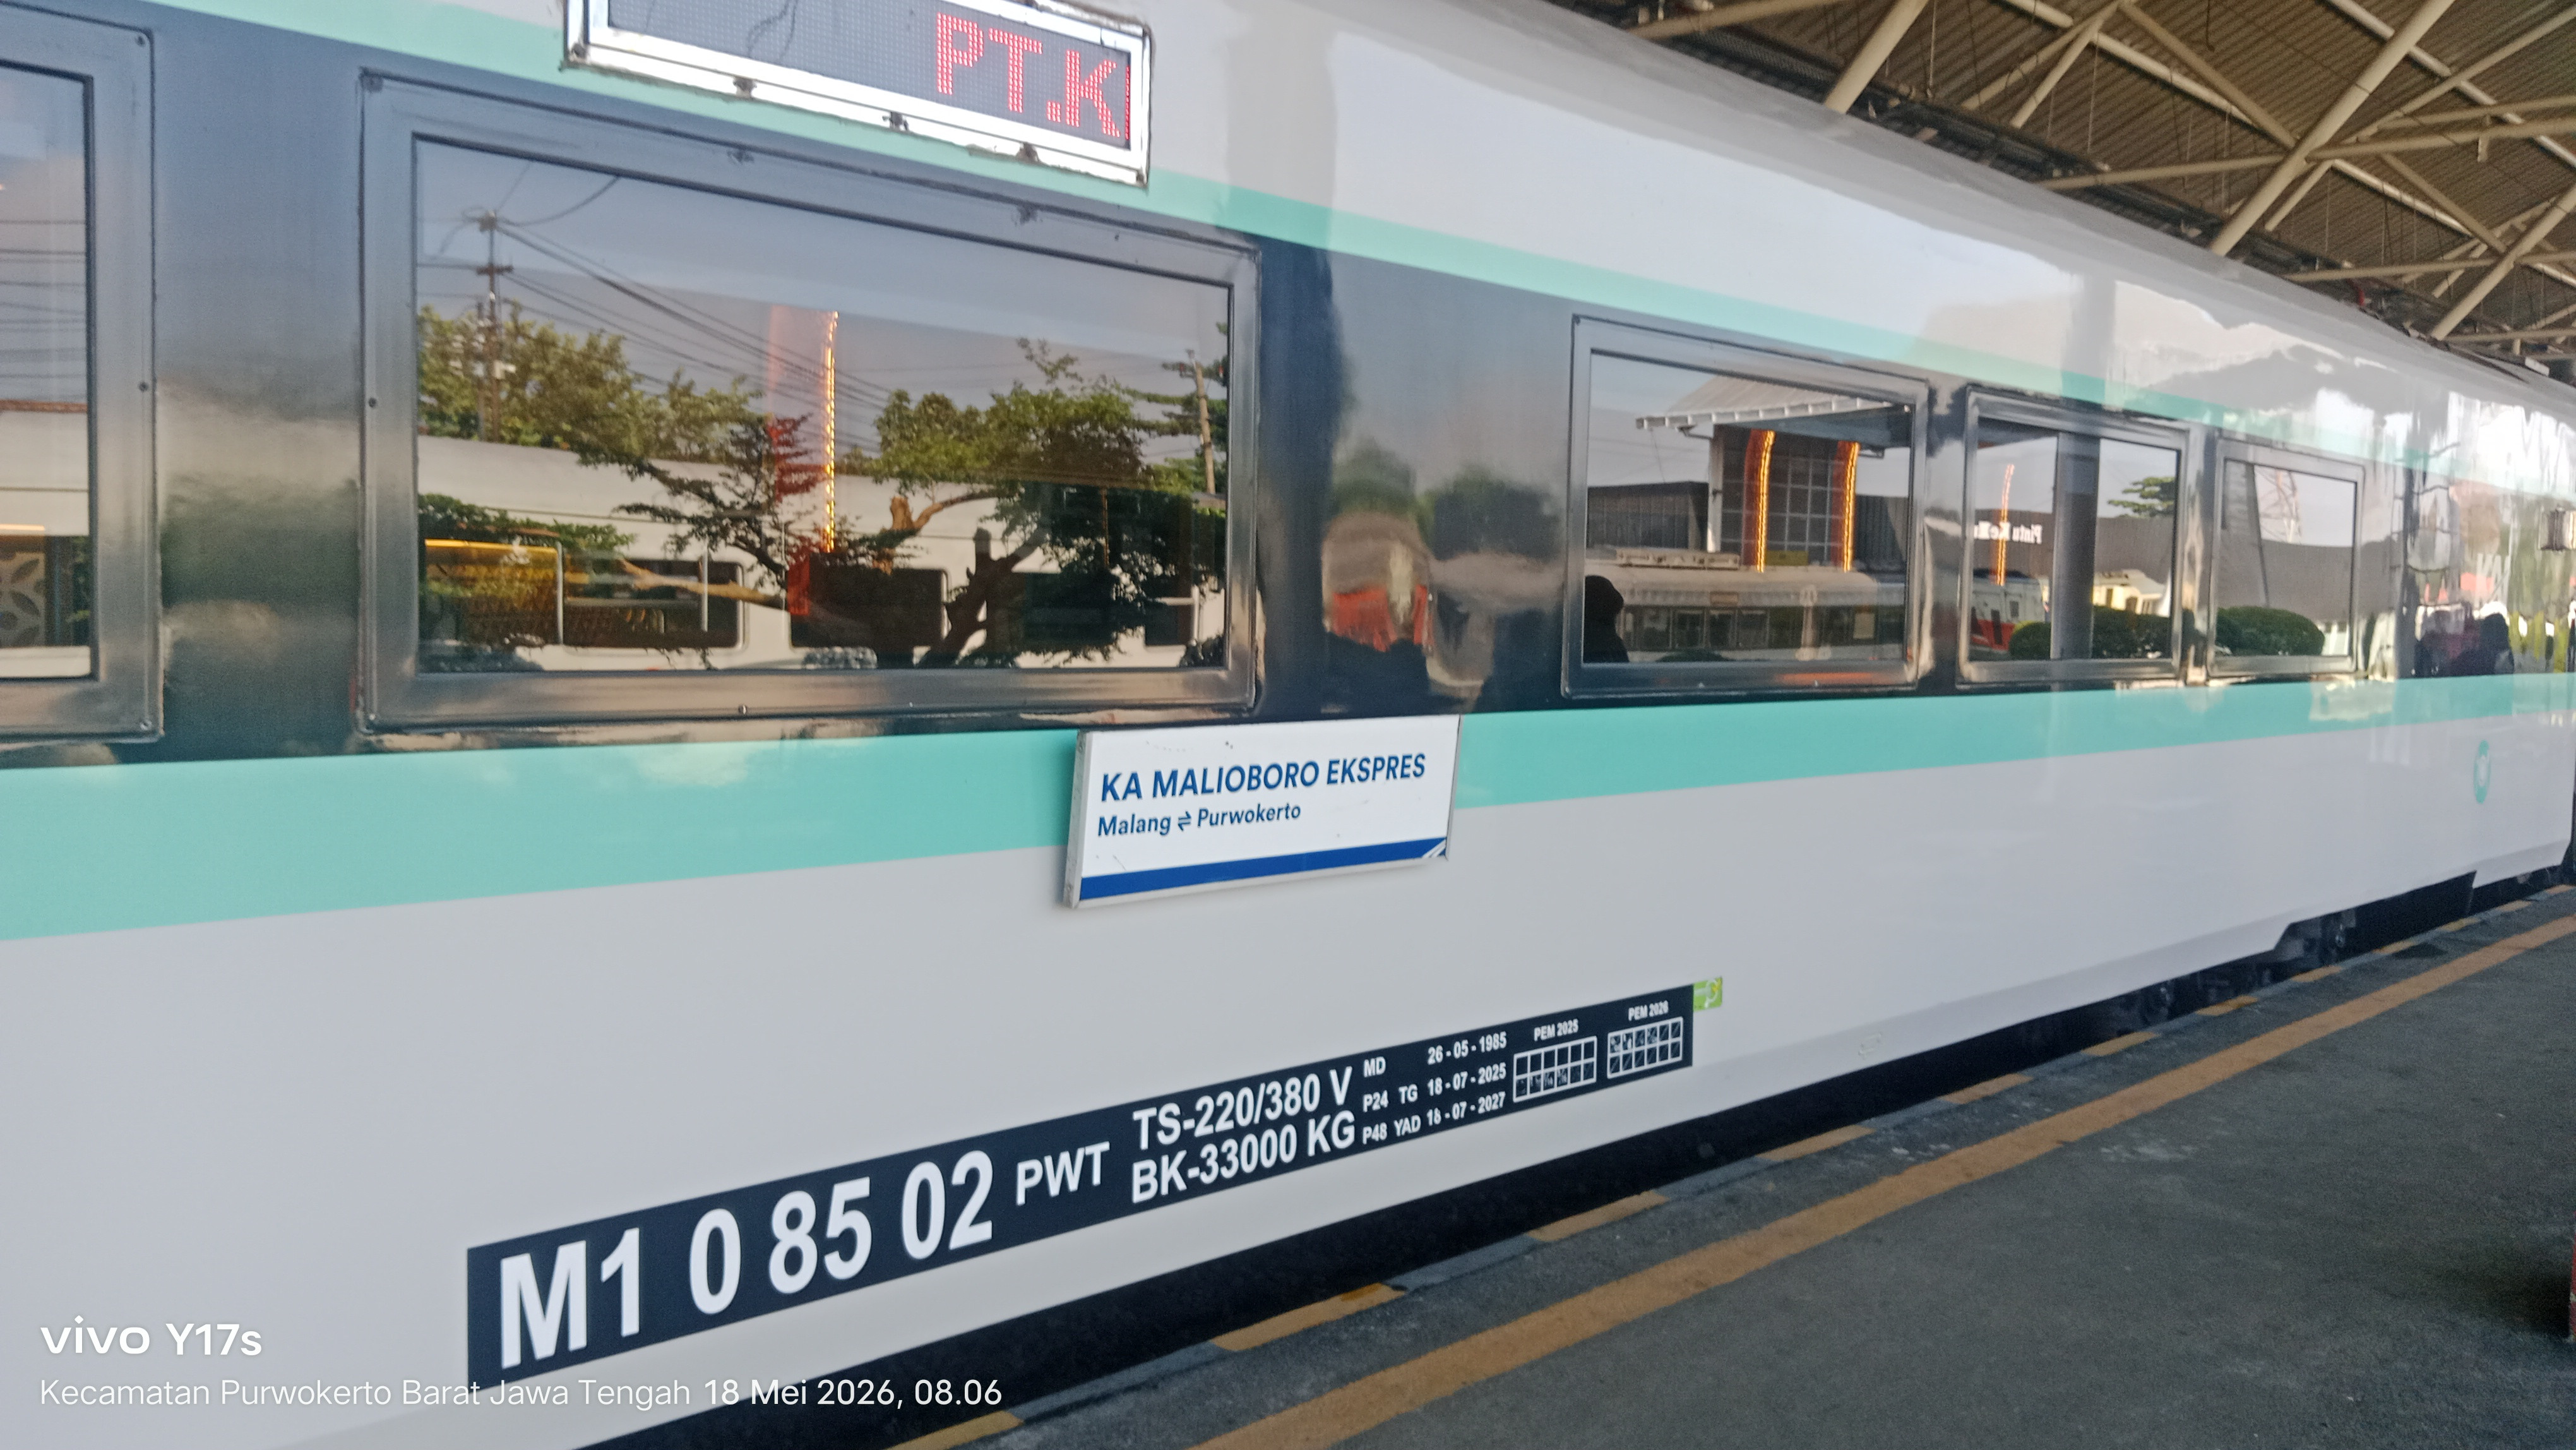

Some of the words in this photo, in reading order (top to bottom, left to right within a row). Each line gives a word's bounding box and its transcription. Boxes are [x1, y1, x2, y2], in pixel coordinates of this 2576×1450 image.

[936, 12, 1131, 141] PT.K
[1101, 772, 1142, 802] KA
[1152, 760, 1320, 798] MALIOBORO
[1327, 753, 1426, 785] EKSPRES
[1098, 813, 1171, 837] Malang
[1197, 803, 1301, 827] Purwokerto
[1628, 1004, 1648, 1021] PEM
[1534, 1024, 1556, 1041] PEM
[1557, 1019, 1579, 1036] 2025
[1363, 1056, 1386, 1078] MD
[1132, 1073, 1320, 1150] TS-220/380
[1329, 1065, 1352, 1106] V
[1363, 1089, 1389, 1113] P24
[1398, 1084, 1418, 1104] TG
[1362, 1122, 1388, 1145] P48
[1393, 1115, 1421, 1137] YAD
[1132, 1123, 1297, 1204] BK-33000
[1308, 1110, 1355, 1157] KG
[500, 1227, 640, 1369] M1
[689, 1208, 741, 1315] 0
[768, 1176, 872, 1294] 85
[901, 1150, 993, 1260] 02
[1016, 1141, 1110, 1206] PWT
